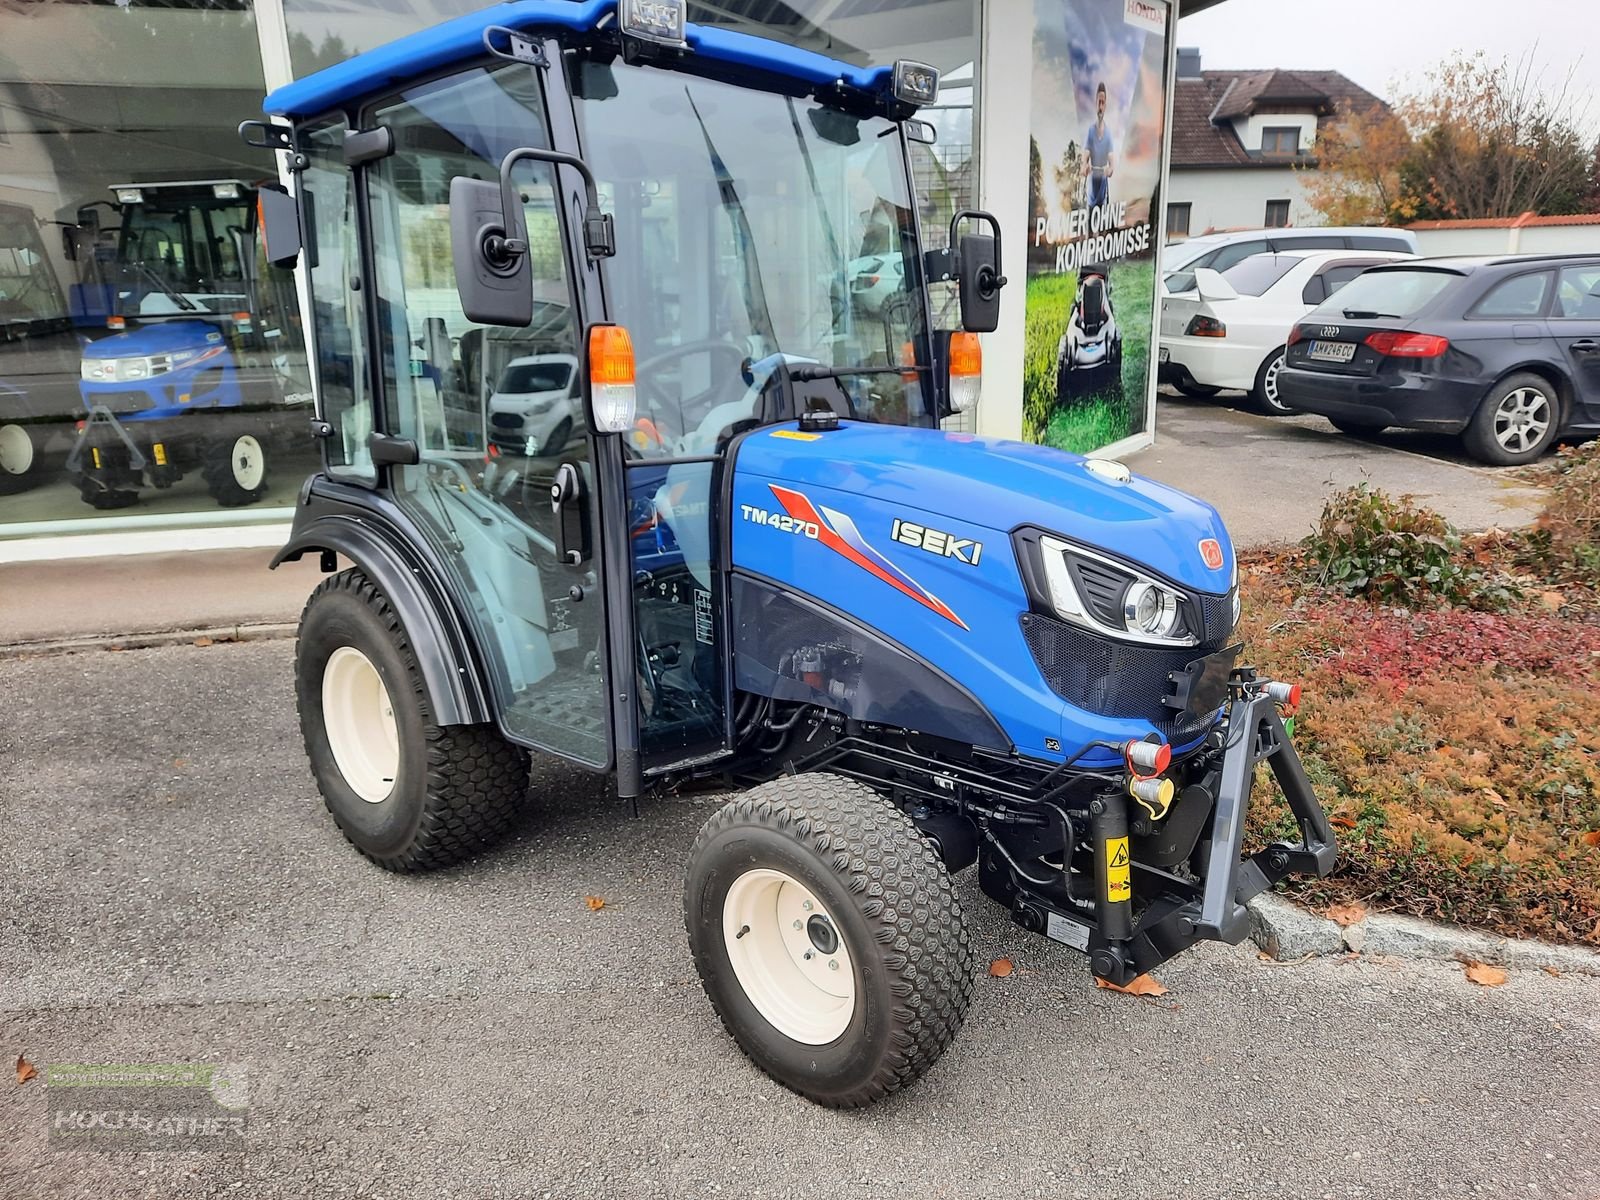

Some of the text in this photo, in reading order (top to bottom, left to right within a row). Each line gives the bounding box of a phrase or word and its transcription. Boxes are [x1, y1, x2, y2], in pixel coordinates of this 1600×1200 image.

[1127, 0, 1162, 24] HONDA
[1035, 201, 1126, 247] POWER OHNE
[1056, 224, 1150, 274] KOMPROMISSE
[740, 504, 820, 540] TM4270
[890, 517, 983, 567] ISEKI
